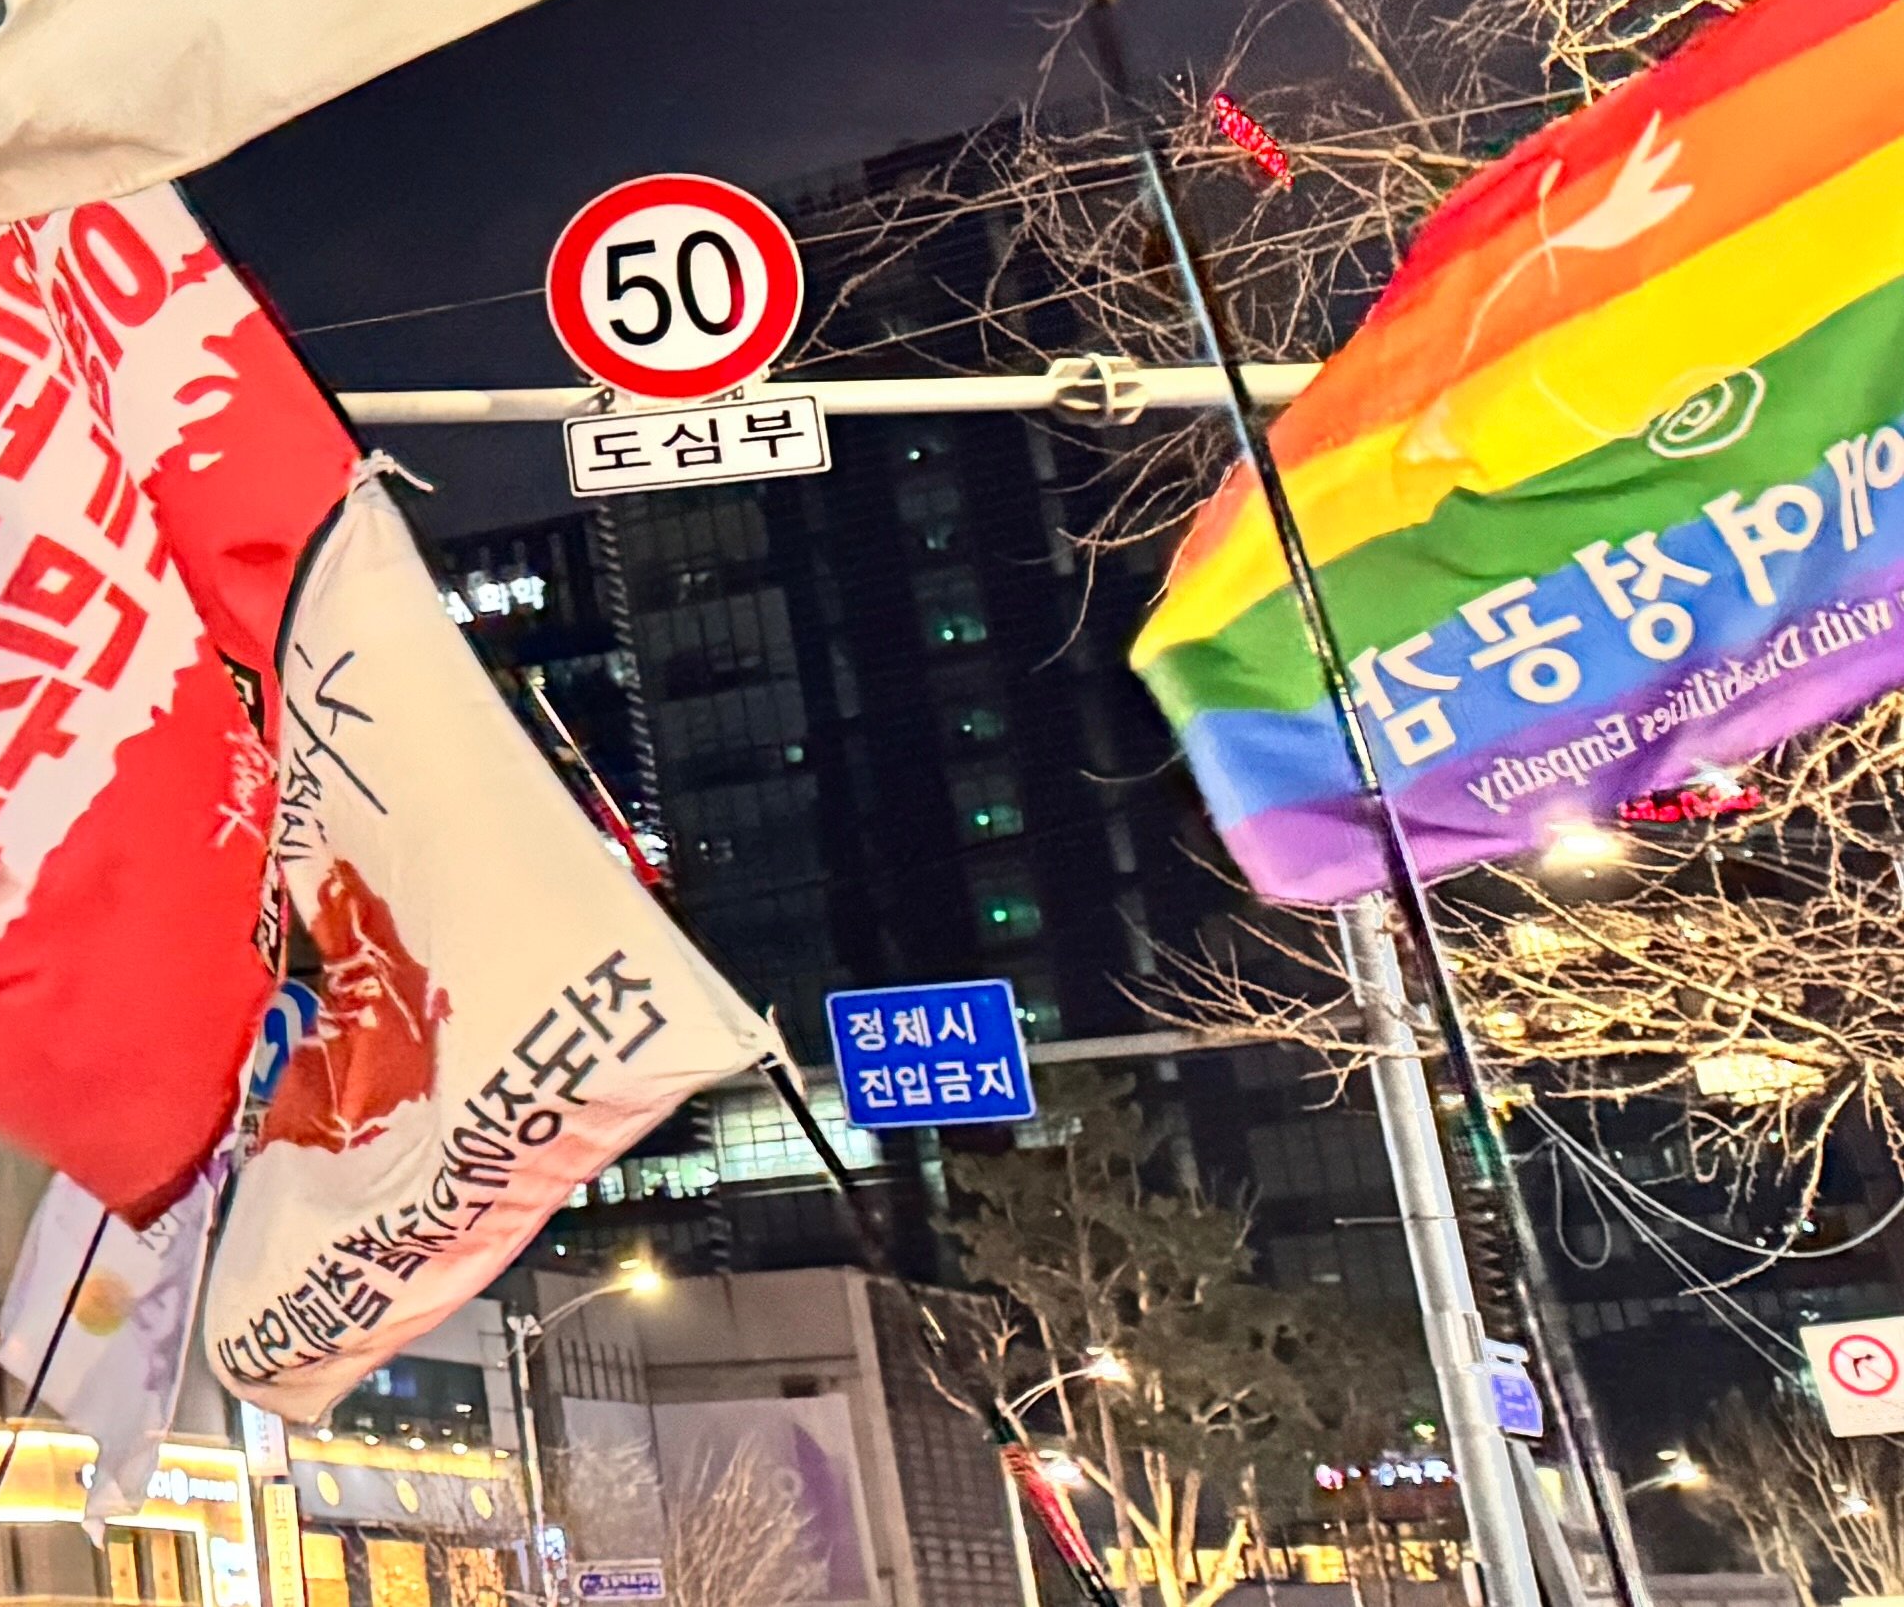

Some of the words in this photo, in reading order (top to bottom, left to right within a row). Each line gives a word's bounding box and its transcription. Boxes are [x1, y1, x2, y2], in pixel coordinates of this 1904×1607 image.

[604, 228, 746, 347] 50
[588, 408, 806, 473] 도심부
[846, 1002, 978, 1055] 정체시
[856, 1057, 1019, 1111] 진입금지
